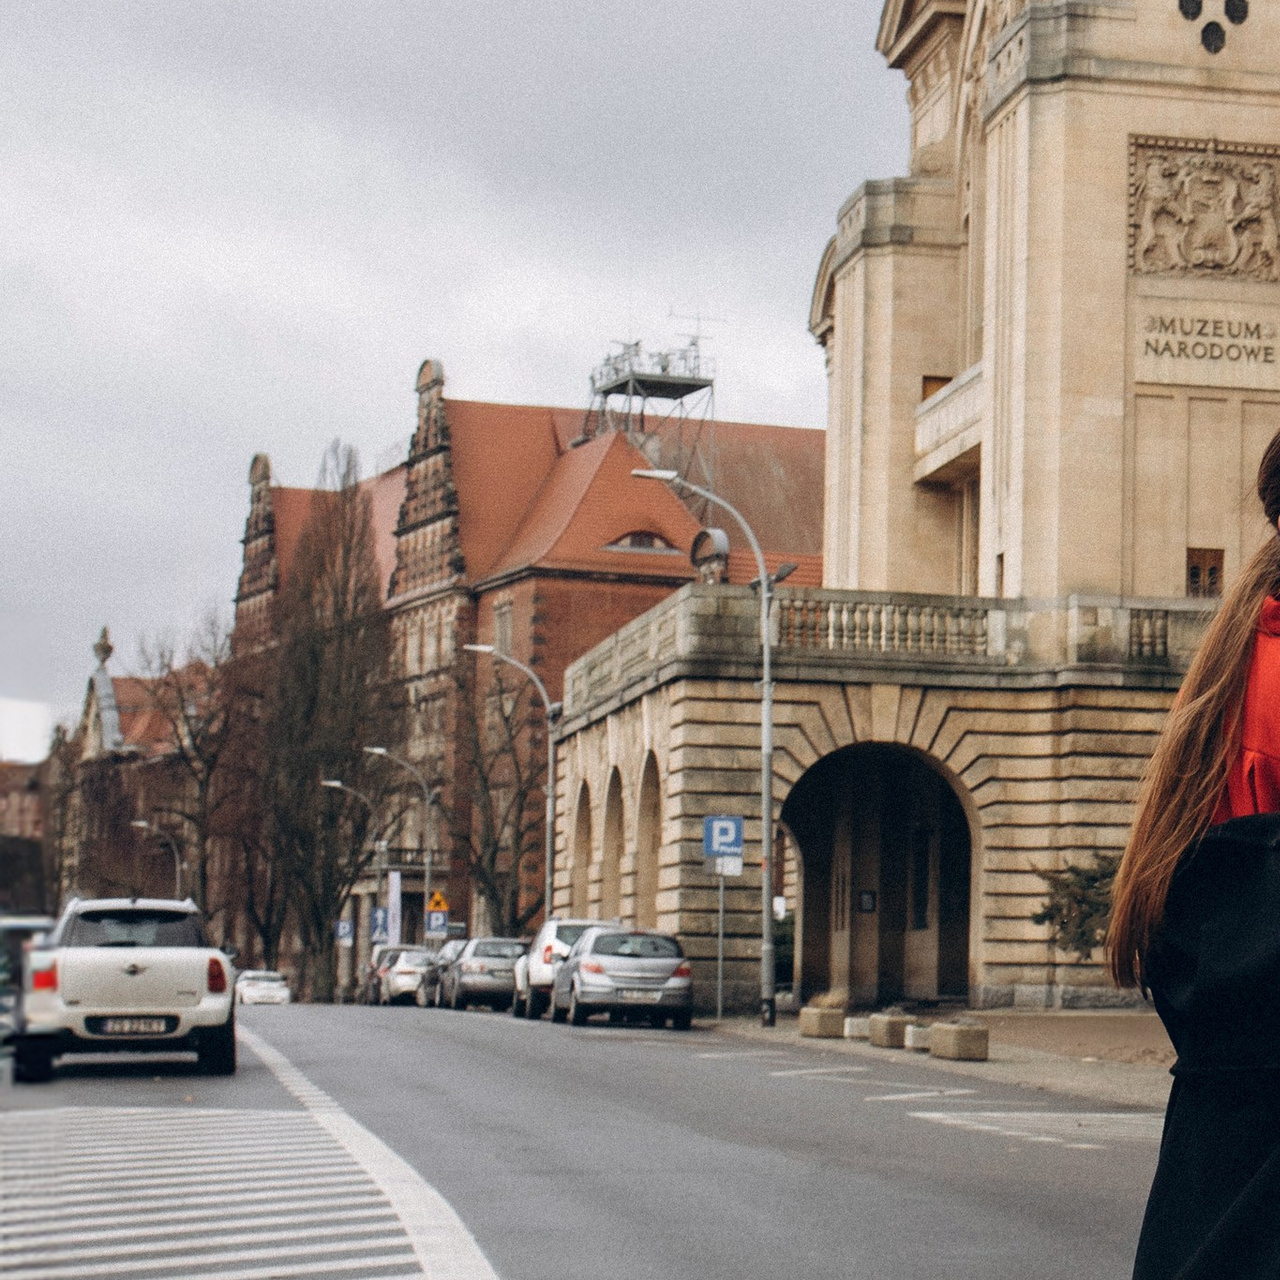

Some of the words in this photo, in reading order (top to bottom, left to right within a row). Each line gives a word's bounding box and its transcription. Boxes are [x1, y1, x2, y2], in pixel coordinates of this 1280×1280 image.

[1158, 318, 1261, 339] MUZEUM
[1144, 340, 1275, 363] NARODOWE
[712, 820, 736, 851] P
[431, 912, 444, 930] P
